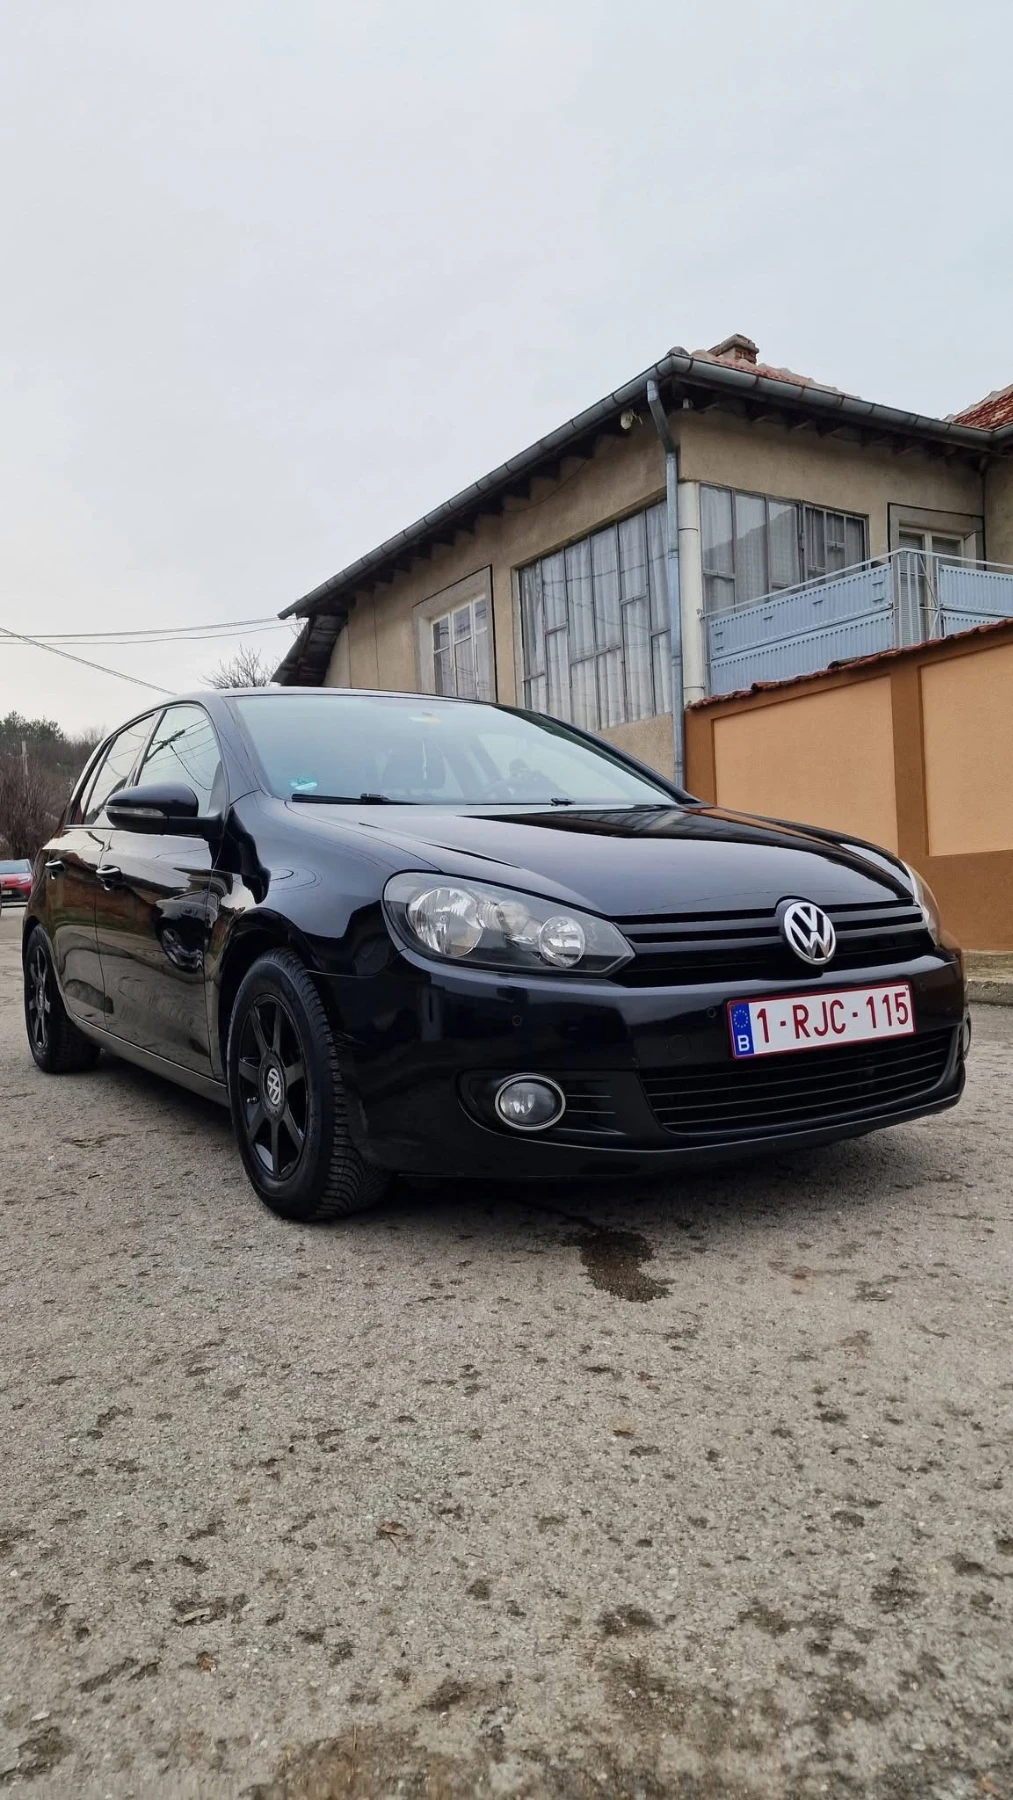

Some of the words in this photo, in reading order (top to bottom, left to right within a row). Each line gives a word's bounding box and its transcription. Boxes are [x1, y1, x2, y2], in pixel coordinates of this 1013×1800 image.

[784, 902, 836, 961] VW
[737, 1034, 750, 1052] B
[757, 992, 909, 1043] 1-RJC-115
